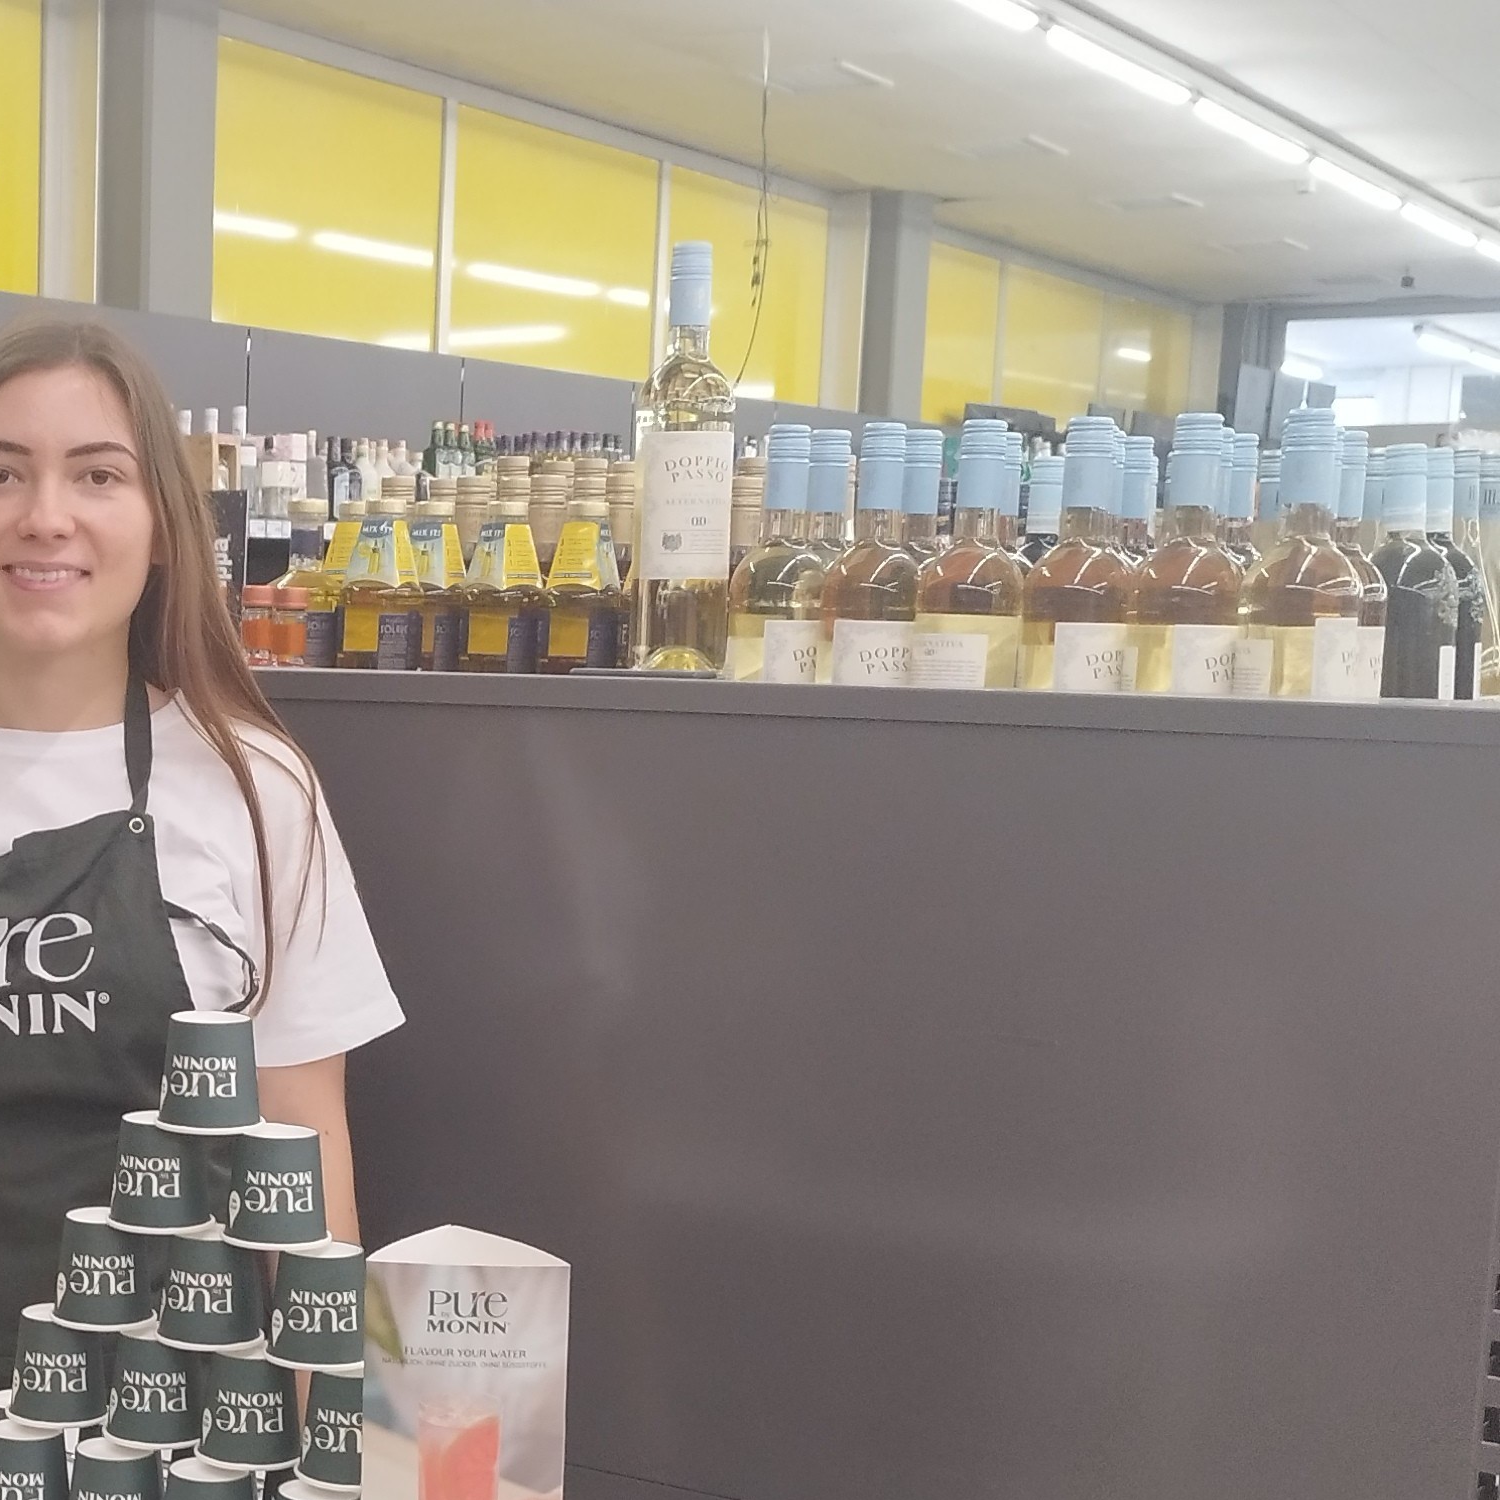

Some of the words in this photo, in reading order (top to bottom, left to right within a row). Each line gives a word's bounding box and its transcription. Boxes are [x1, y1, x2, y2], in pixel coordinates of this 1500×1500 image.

[665, 455, 729, 472] DOPPIO
[671, 469, 724, 483] PASSO
[859, 647, 911, 662] DOPP
[1086, 651, 1122, 667] DOP
[866, 660, 909, 675] PASS
[1094, 664, 1122, 680] PAS
[172, 1054, 237, 1071] MONIN
[119, 1154, 181, 1171] MONIN
[245, 1170, 313, 1187] MONIN
[71, 1252, 135, 1270] MONIN
[170, 1268, 233, 1287] MONIN
[289, 1288, 357, 1307] MONIN
[426, 1319, 508, 1335] MONIN
[25, 1350, 87, 1368] MONIN
[404, 1346, 454, 1357] FLAVOUR
[458, 1348, 487, 1358] YOUR
[490, 1349, 527, 1359] WATER
[123, 1368, 186, 1387] MONIN
[217, 1389, 283, 1408] MONIN
[316, 1408, 363, 1428] ONIN
[314, 1424, 363, 1454] ure
